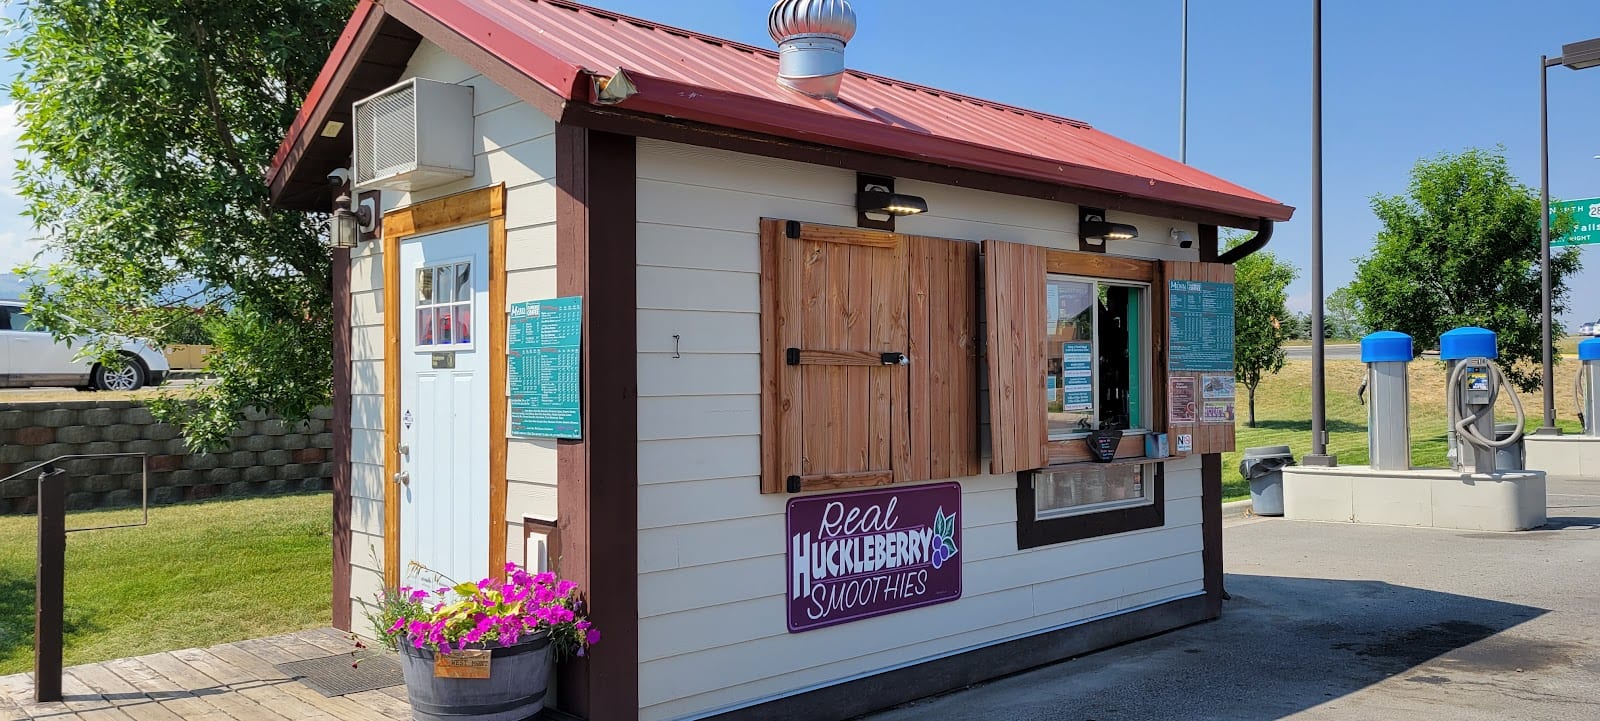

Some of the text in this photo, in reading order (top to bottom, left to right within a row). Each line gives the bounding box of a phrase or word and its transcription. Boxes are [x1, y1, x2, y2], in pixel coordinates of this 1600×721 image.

[818, 496, 899, 539] Real
[793, 527, 933, 600] HUCKLEBERRY
[807, 569, 928, 620] SMOOTHIES
